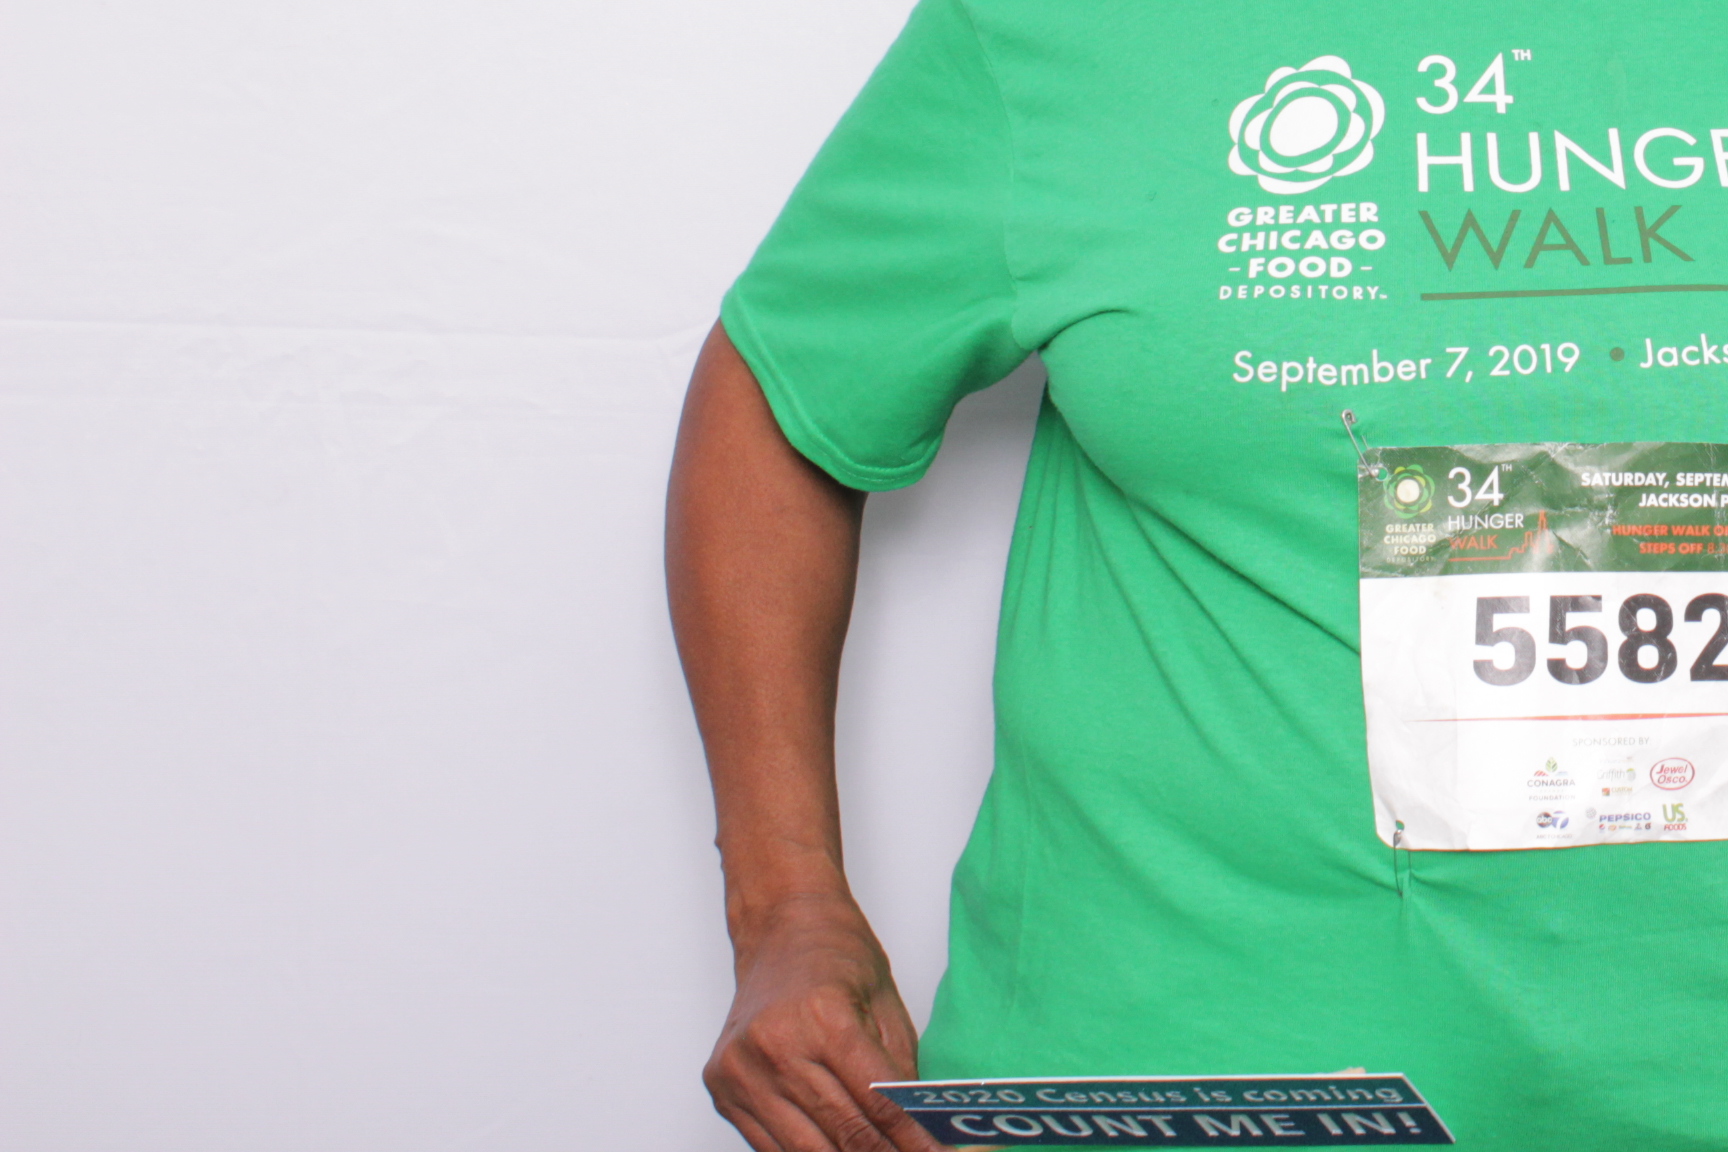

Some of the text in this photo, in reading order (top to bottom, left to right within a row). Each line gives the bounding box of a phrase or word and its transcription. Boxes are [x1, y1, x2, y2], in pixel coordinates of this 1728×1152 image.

[1227, 201, 1379, 228] GREATER
[1217, 228, 1387, 253] CHICAGO
[1417, 204, 1696, 272] WALK
[1232, 349, 1432, 392] September
[1445, 347, 1474, 383] 7,
[1488, 342, 1580, 376] 2019
[1580, 472, 1670, 489] SATURDAY,
[1639, 493, 1716, 508] JACKSON
[1385, 523, 1435, 534] GREATER
[1448, 513, 1524, 530] HUNGER
[1612, 525, 1669, 537] HUNGER
[1671, 525, 1711, 536] WALK
[1383, 534, 1437, 545] CHICAGO
[1450, 534, 1499, 549] WALK
[1639, 542, 1676, 554] STEPS
[1678, 543, 1703, 554] OFF
[1572, 736, 1650, 747] SPONSORED BY
[1656, 763, 1688, 775] Jewel
[1527, 779, 1576, 788] CONAGRA
[1599, 812, 1651, 822] PEPSICO
[1664, 823, 1687, 831] FOODS
[913, 1085, 1403, 1104] 2020 Census is coming
[950, 1111, 1422, 1138] COUNT ME IN!
